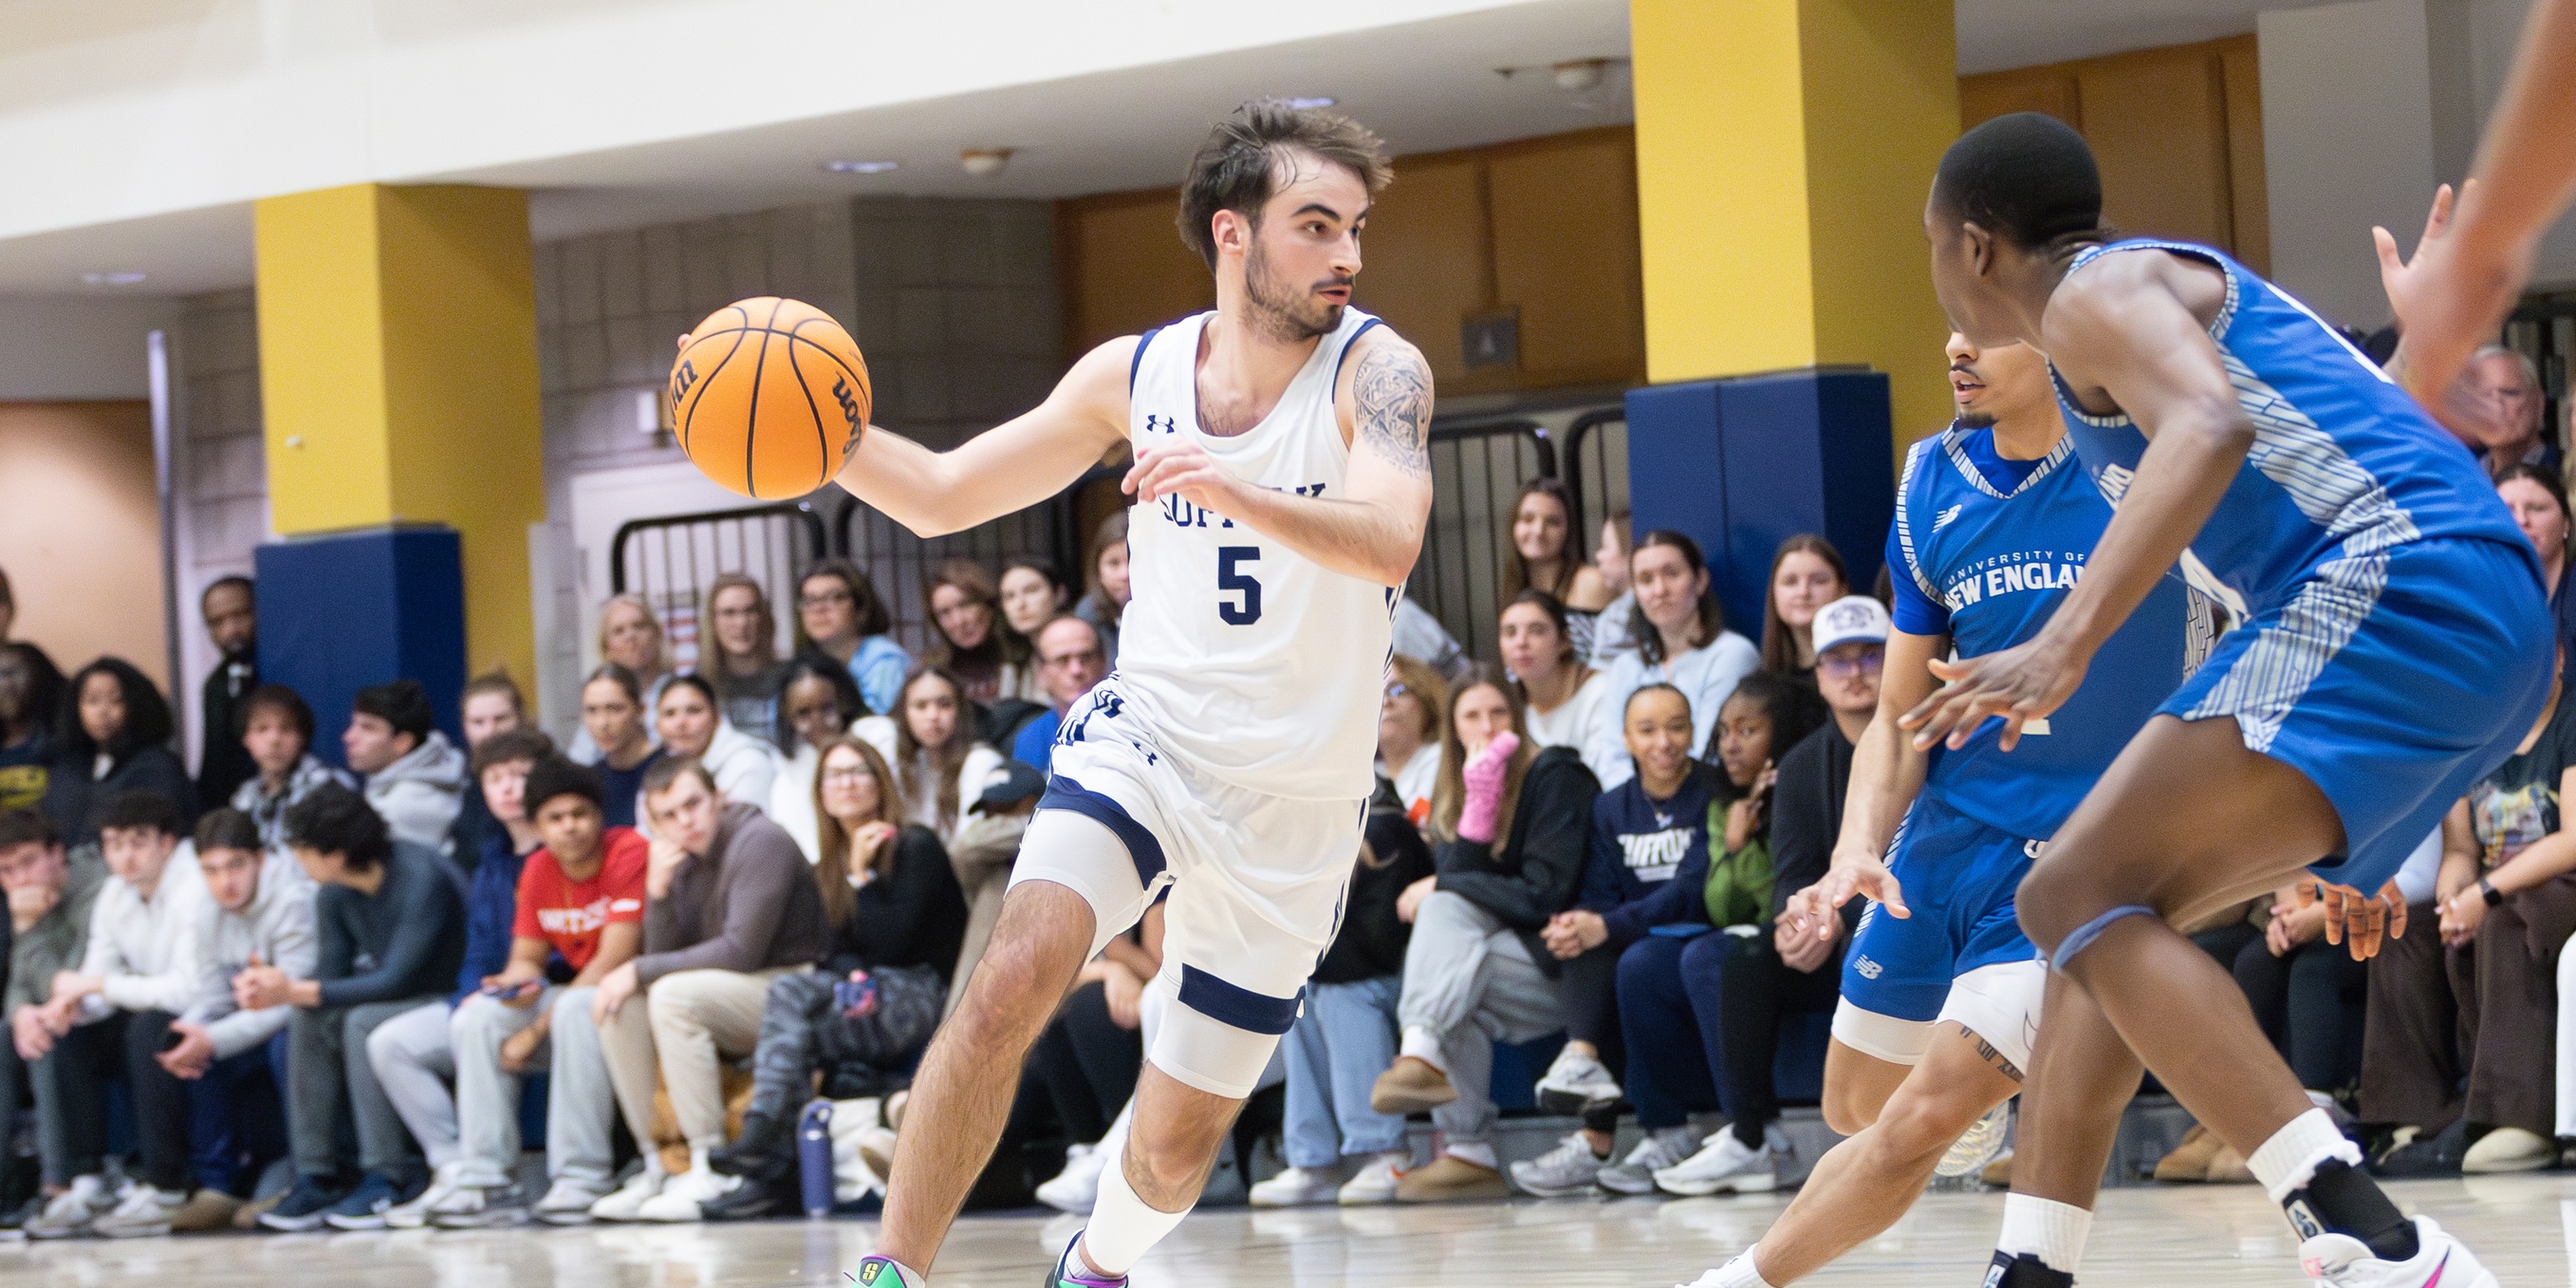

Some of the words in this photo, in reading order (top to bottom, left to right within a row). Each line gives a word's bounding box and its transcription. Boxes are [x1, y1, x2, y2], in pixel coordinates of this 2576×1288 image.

[1218, 546, 1262, 625] 5
[1945, 573, 1982, 614] NEW
[1985, 562, 2085, 597] ENGLA
[1948, 551, 2053, 586] UNIVERSITY
[2065, 552, 2085, 562] OF
